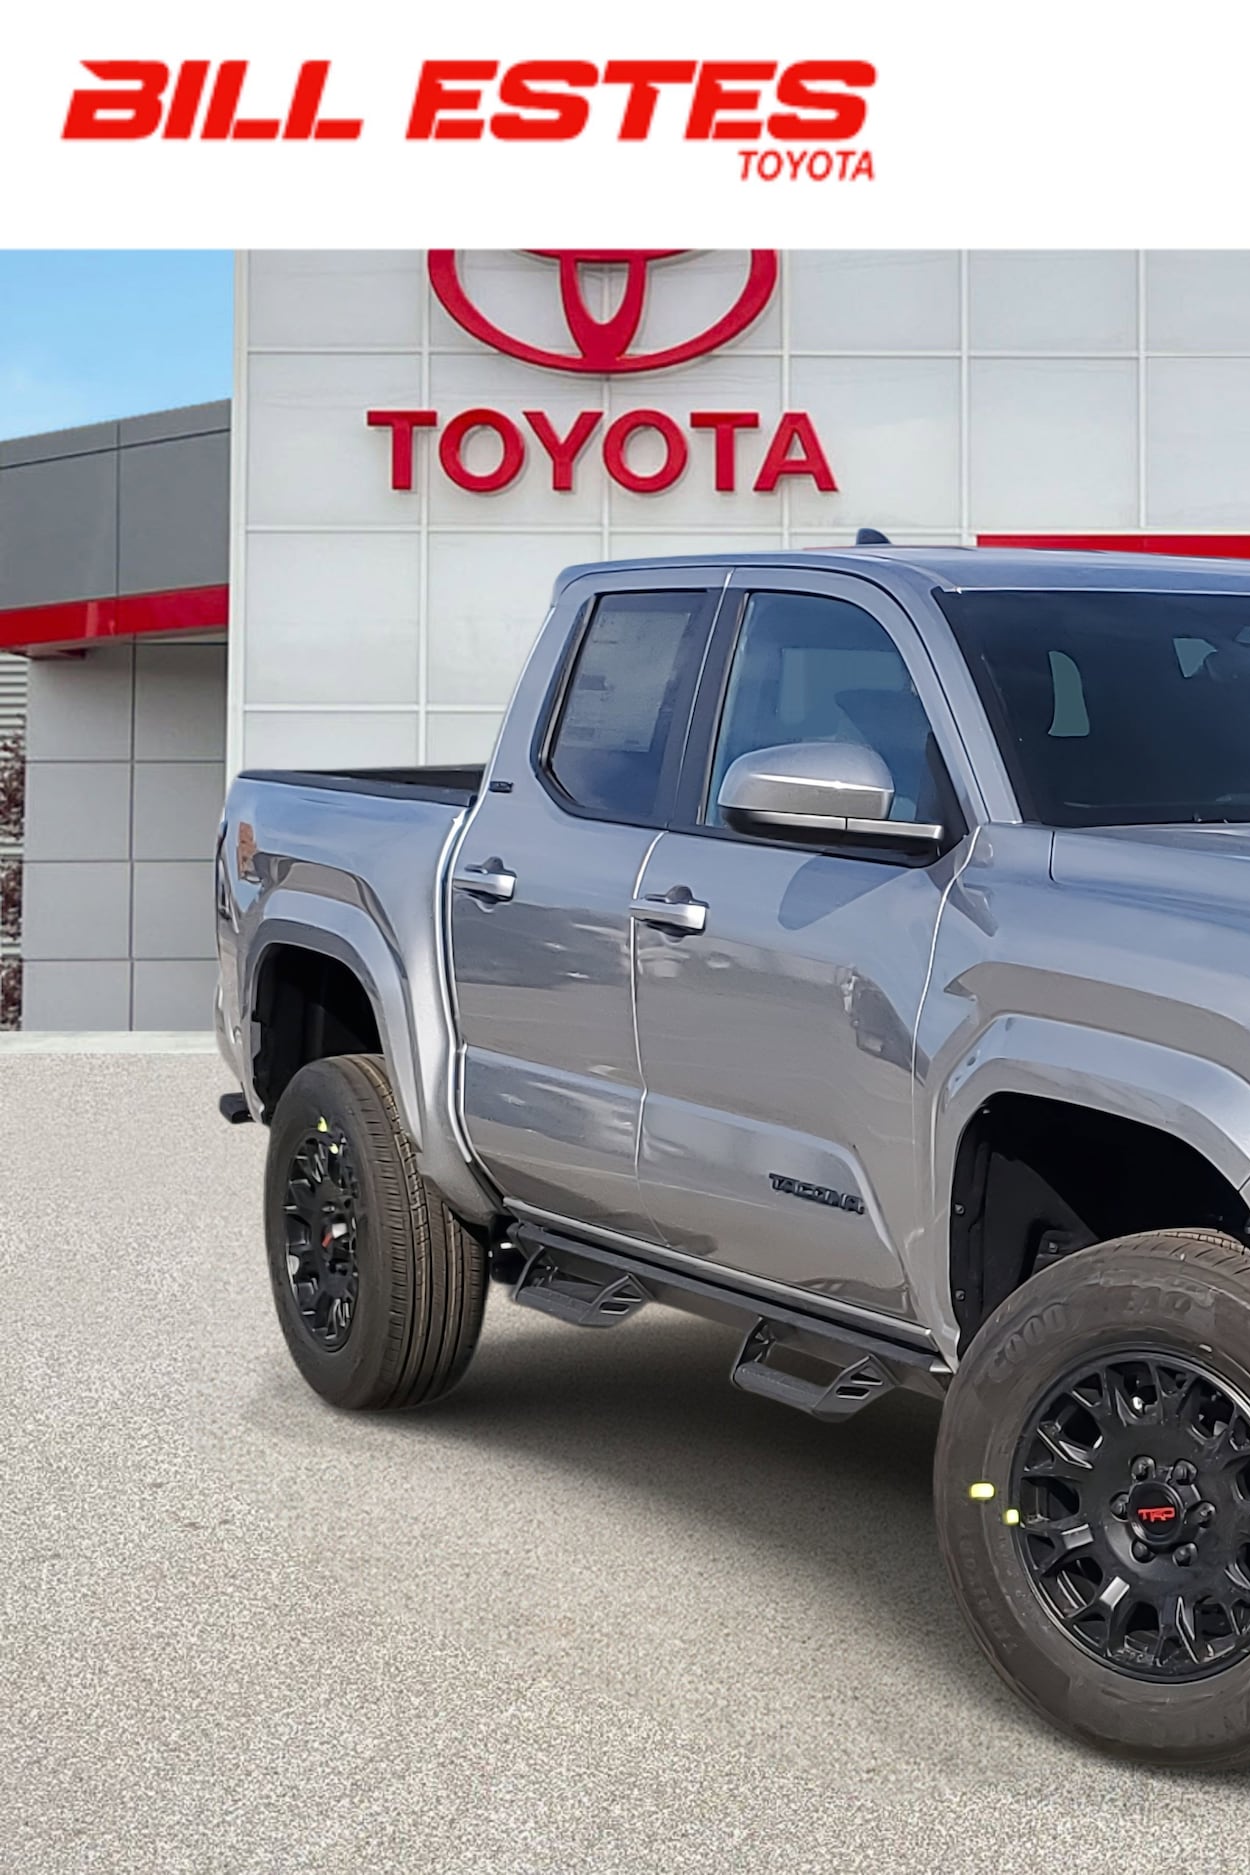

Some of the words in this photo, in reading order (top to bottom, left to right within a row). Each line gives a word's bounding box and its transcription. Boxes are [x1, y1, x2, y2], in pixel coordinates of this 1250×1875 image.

[368, 409, 838, 493] TOYOTA
[768, 1172, 865, 1215] TACOMA
[1137, 1506, 1176, 1523] TRD
